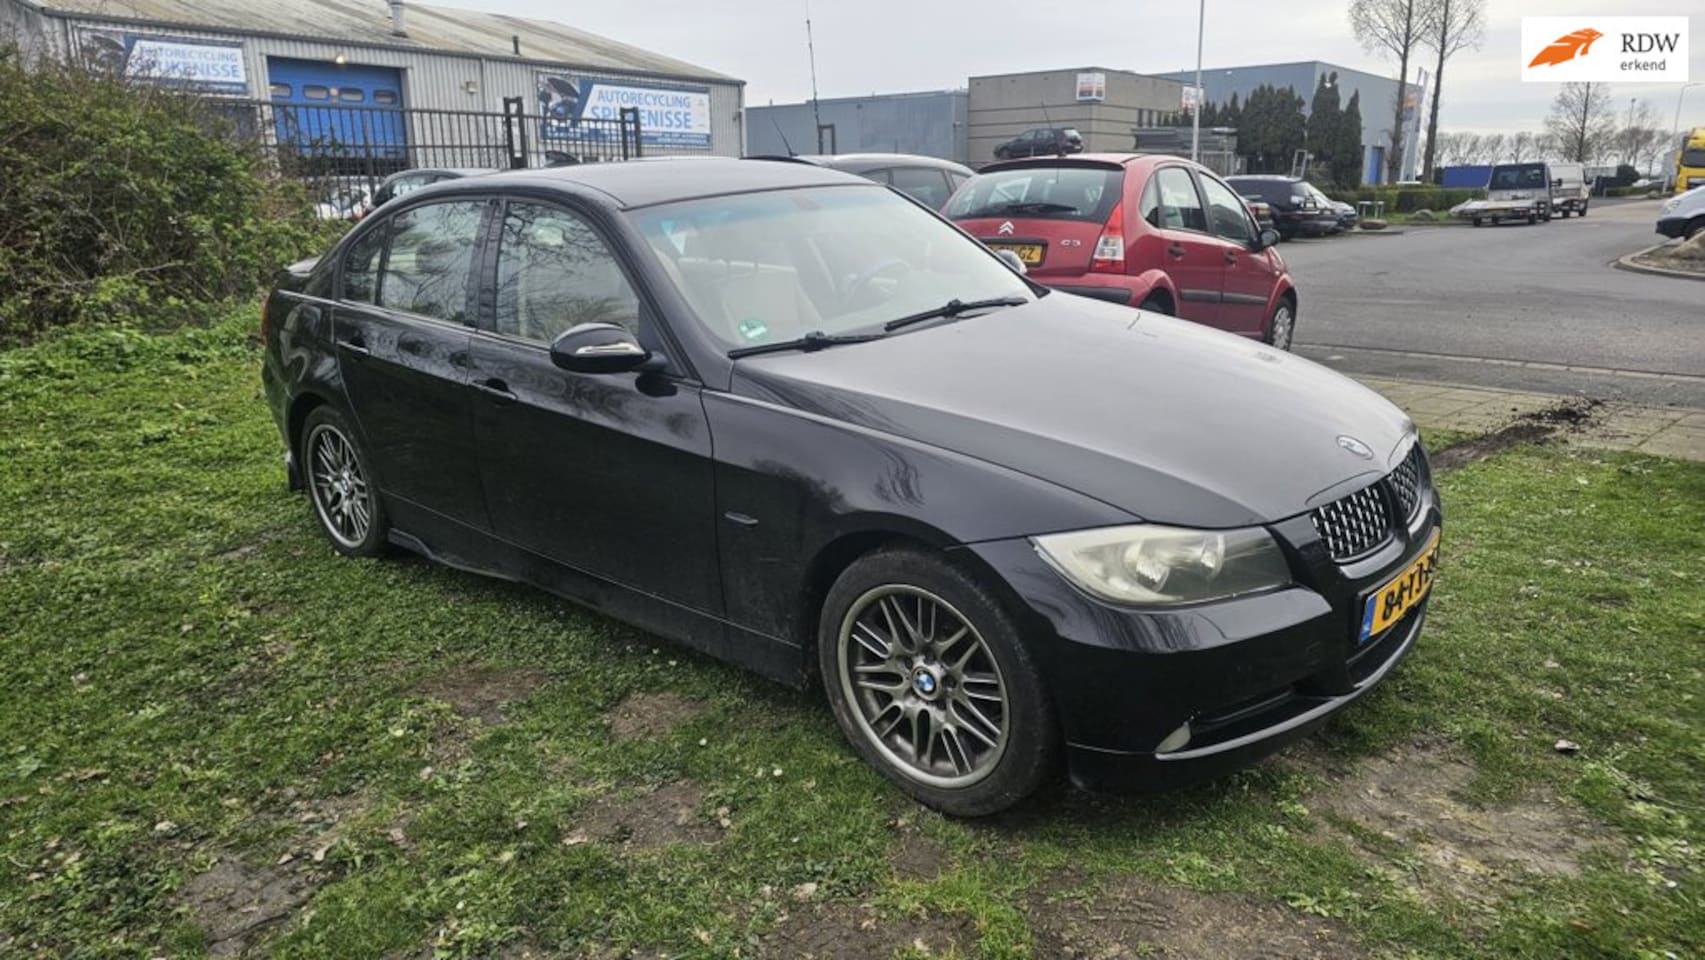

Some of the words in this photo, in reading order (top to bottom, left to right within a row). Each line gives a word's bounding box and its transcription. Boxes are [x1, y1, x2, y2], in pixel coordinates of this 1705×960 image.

[134, 57, 241, 78] IJKENISSE
[597, 90, 692, 108] AUTORECYCLING
[591, 106, 692, 129] SPIENISSE
